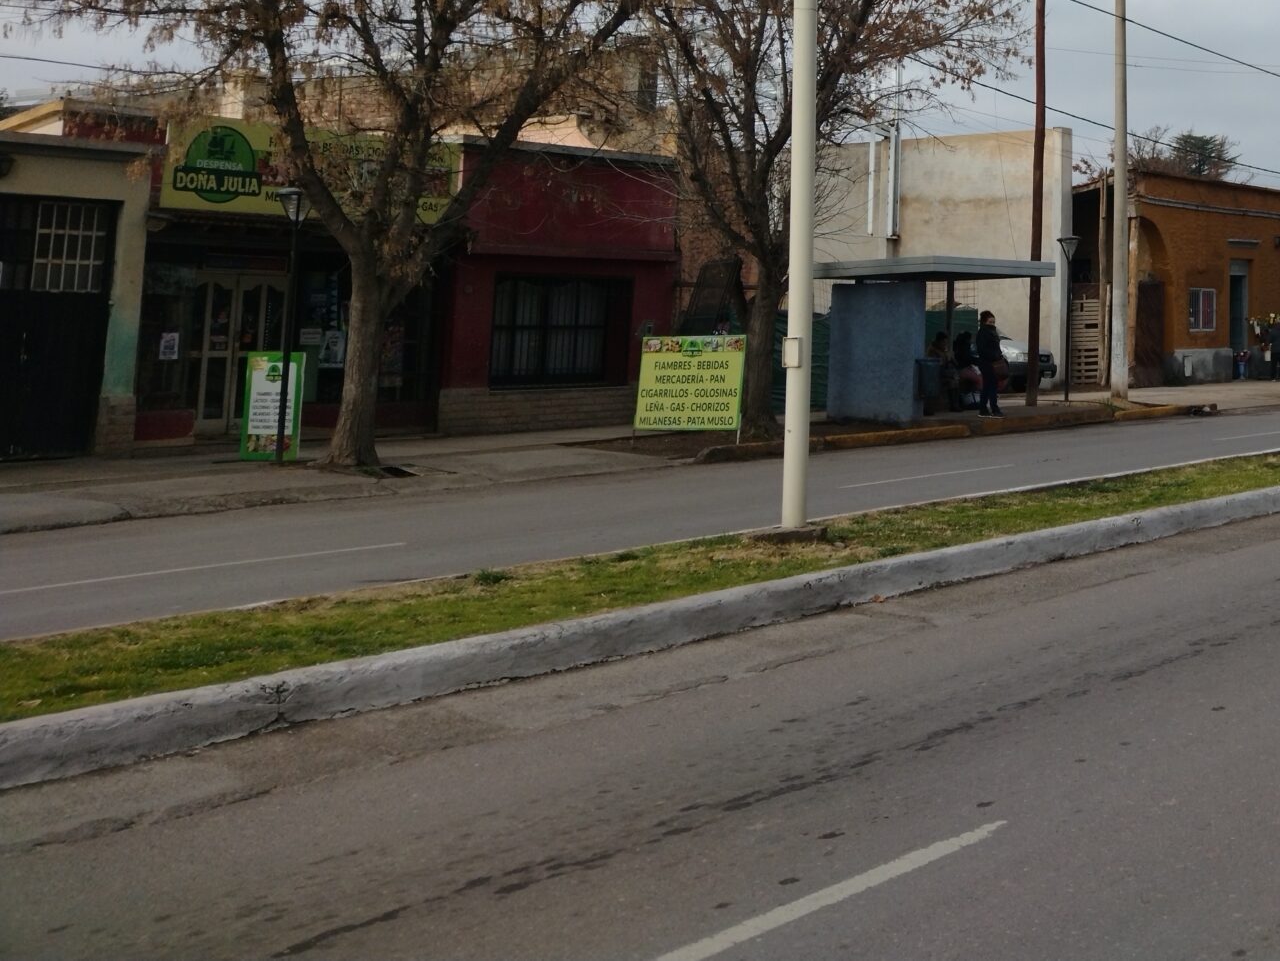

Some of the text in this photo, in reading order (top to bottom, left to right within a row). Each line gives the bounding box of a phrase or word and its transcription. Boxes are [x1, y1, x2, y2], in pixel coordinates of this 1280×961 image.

[196, 159, 243, 171] DESPENSA
[175, 170, 259, 193] DOÑA JULIA
[654, 361, 692, 371] FIAMBRES
[696, 360, 729, 370] BEBIDAS
[655, 373, 704, 384] MERCADERÍA
[709, 374, 726, 384] PAN
[640, 388, 689, 398] CIGARRILLOS
[694, 388, 738, 398] GOLOSINAS
[645, 401, 664, 412] LEÑA
[670, 402, 686, 412] GAS
[690, 402, 730, 412] CHORIZOS
[639, 416, 682, 426] MILANESAS
[687, 416, 706, 426] PATA
[707, 416, 734, 426] MUSLO
